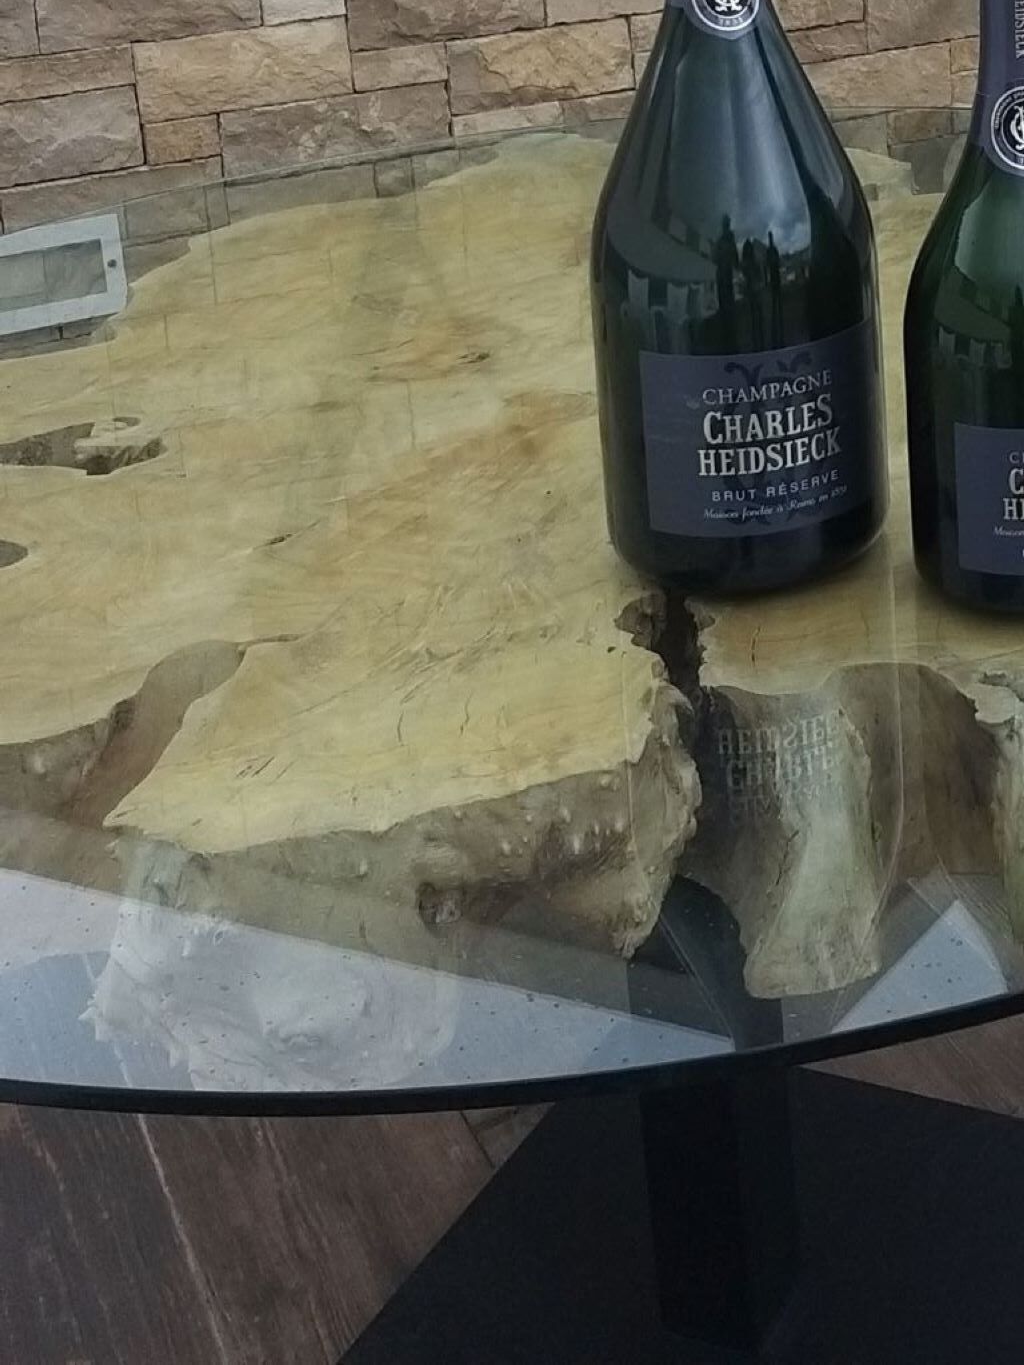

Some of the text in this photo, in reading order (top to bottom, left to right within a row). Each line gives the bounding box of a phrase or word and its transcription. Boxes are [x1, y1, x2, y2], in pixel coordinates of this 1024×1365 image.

[702, 369, 832, 406] CHAMPAGNE
[703, 393, 833, 445] CHARLES
[698, 426, 842, 476] HEIDSIECK
[711, 469, 839, 502] BRUT RÉSERVE
